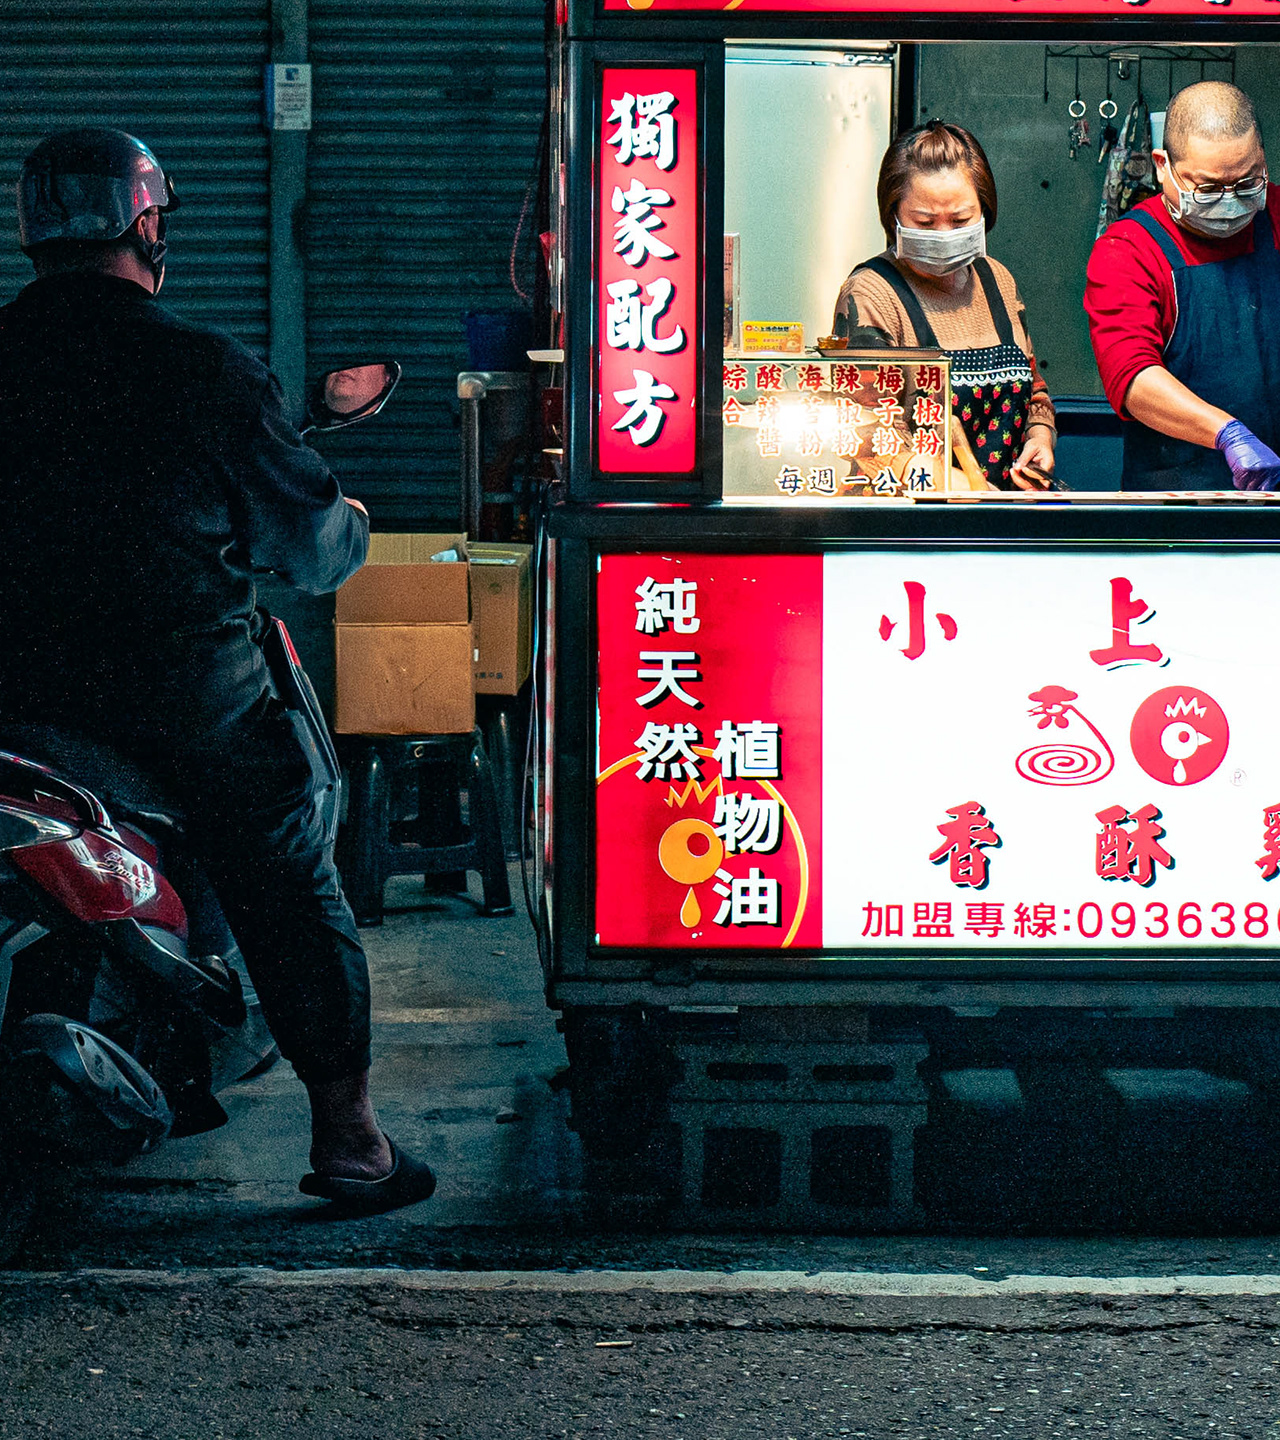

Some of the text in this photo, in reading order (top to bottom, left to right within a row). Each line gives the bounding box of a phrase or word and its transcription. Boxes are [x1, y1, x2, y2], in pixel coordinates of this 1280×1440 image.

[606, 90, 687, 448] 獨家配方
[776, 463, 935, 496] 每週一公休
[872, 363, 905, 457] 梅子粉
[913, 363, 945, 457] 胡椒粉
[634, 575, 704, 783] 純天然
[712, 719, 784, 929] 植物油
